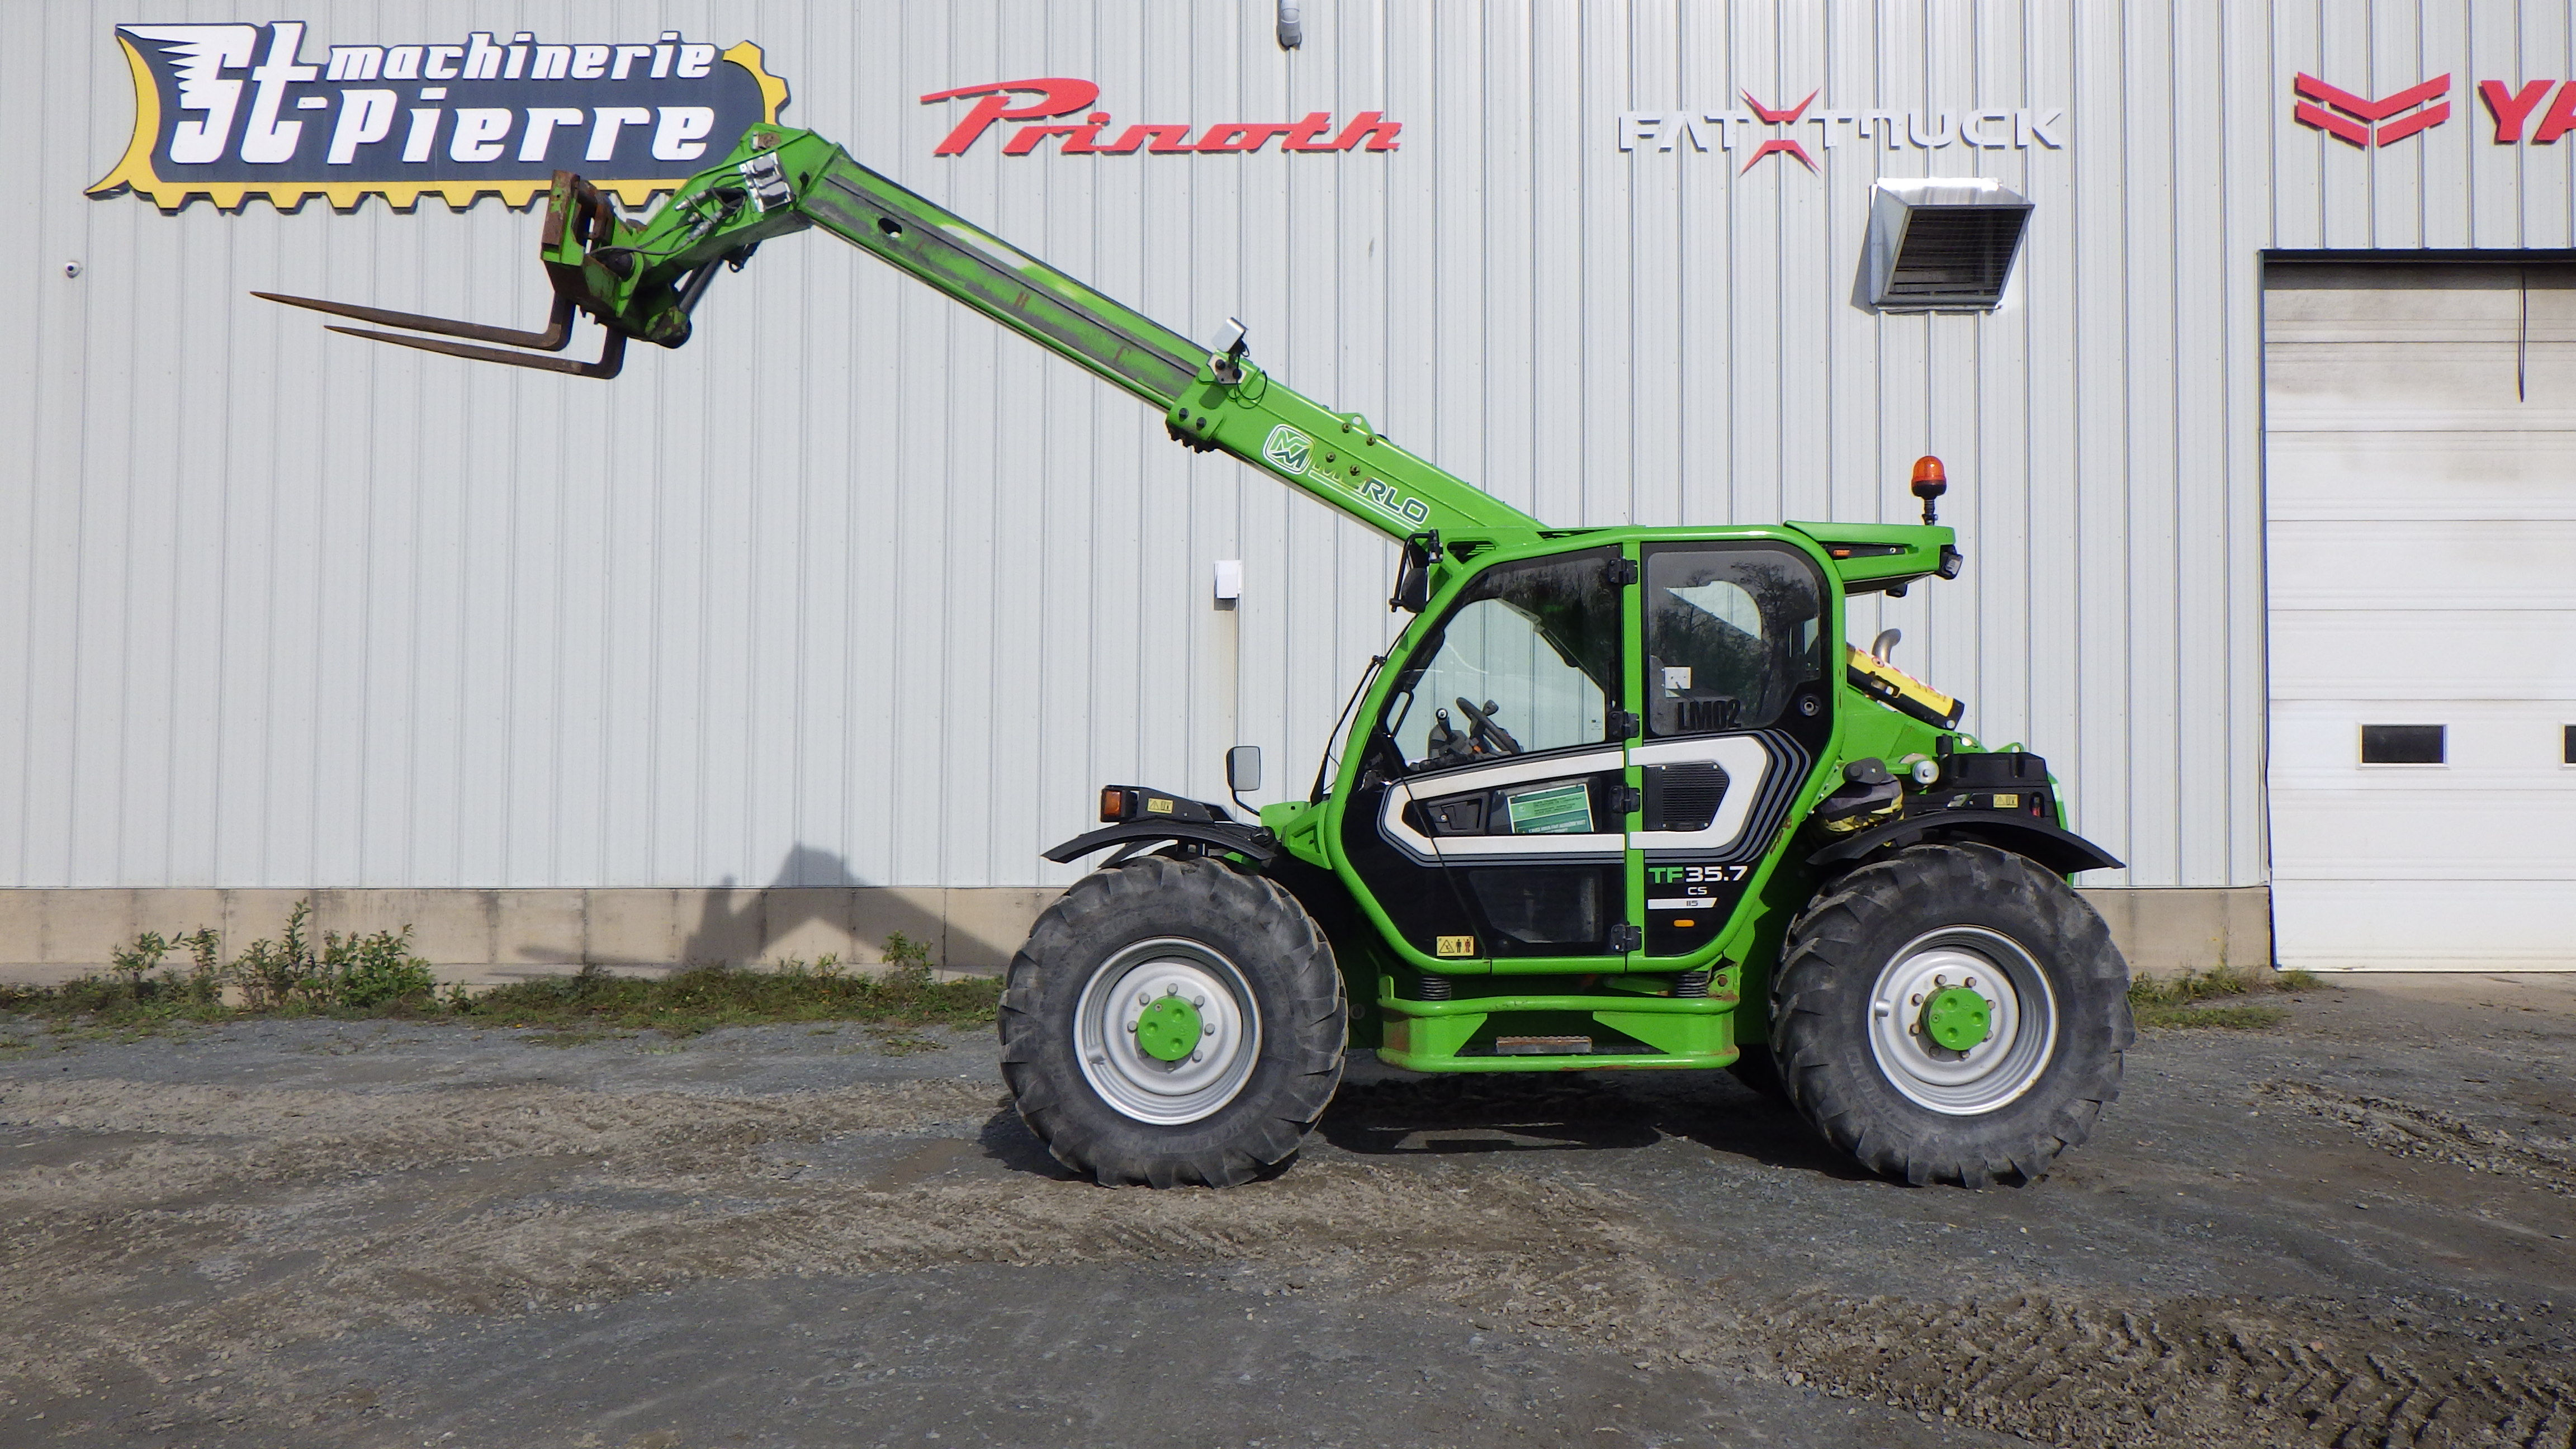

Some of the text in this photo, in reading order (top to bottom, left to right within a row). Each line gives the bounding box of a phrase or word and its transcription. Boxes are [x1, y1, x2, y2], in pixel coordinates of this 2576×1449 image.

[326, 33, 715, 80] machinerie
[921, 78, 1401, 154] Prinoth
[1687, 887, 1708, 896] CS
